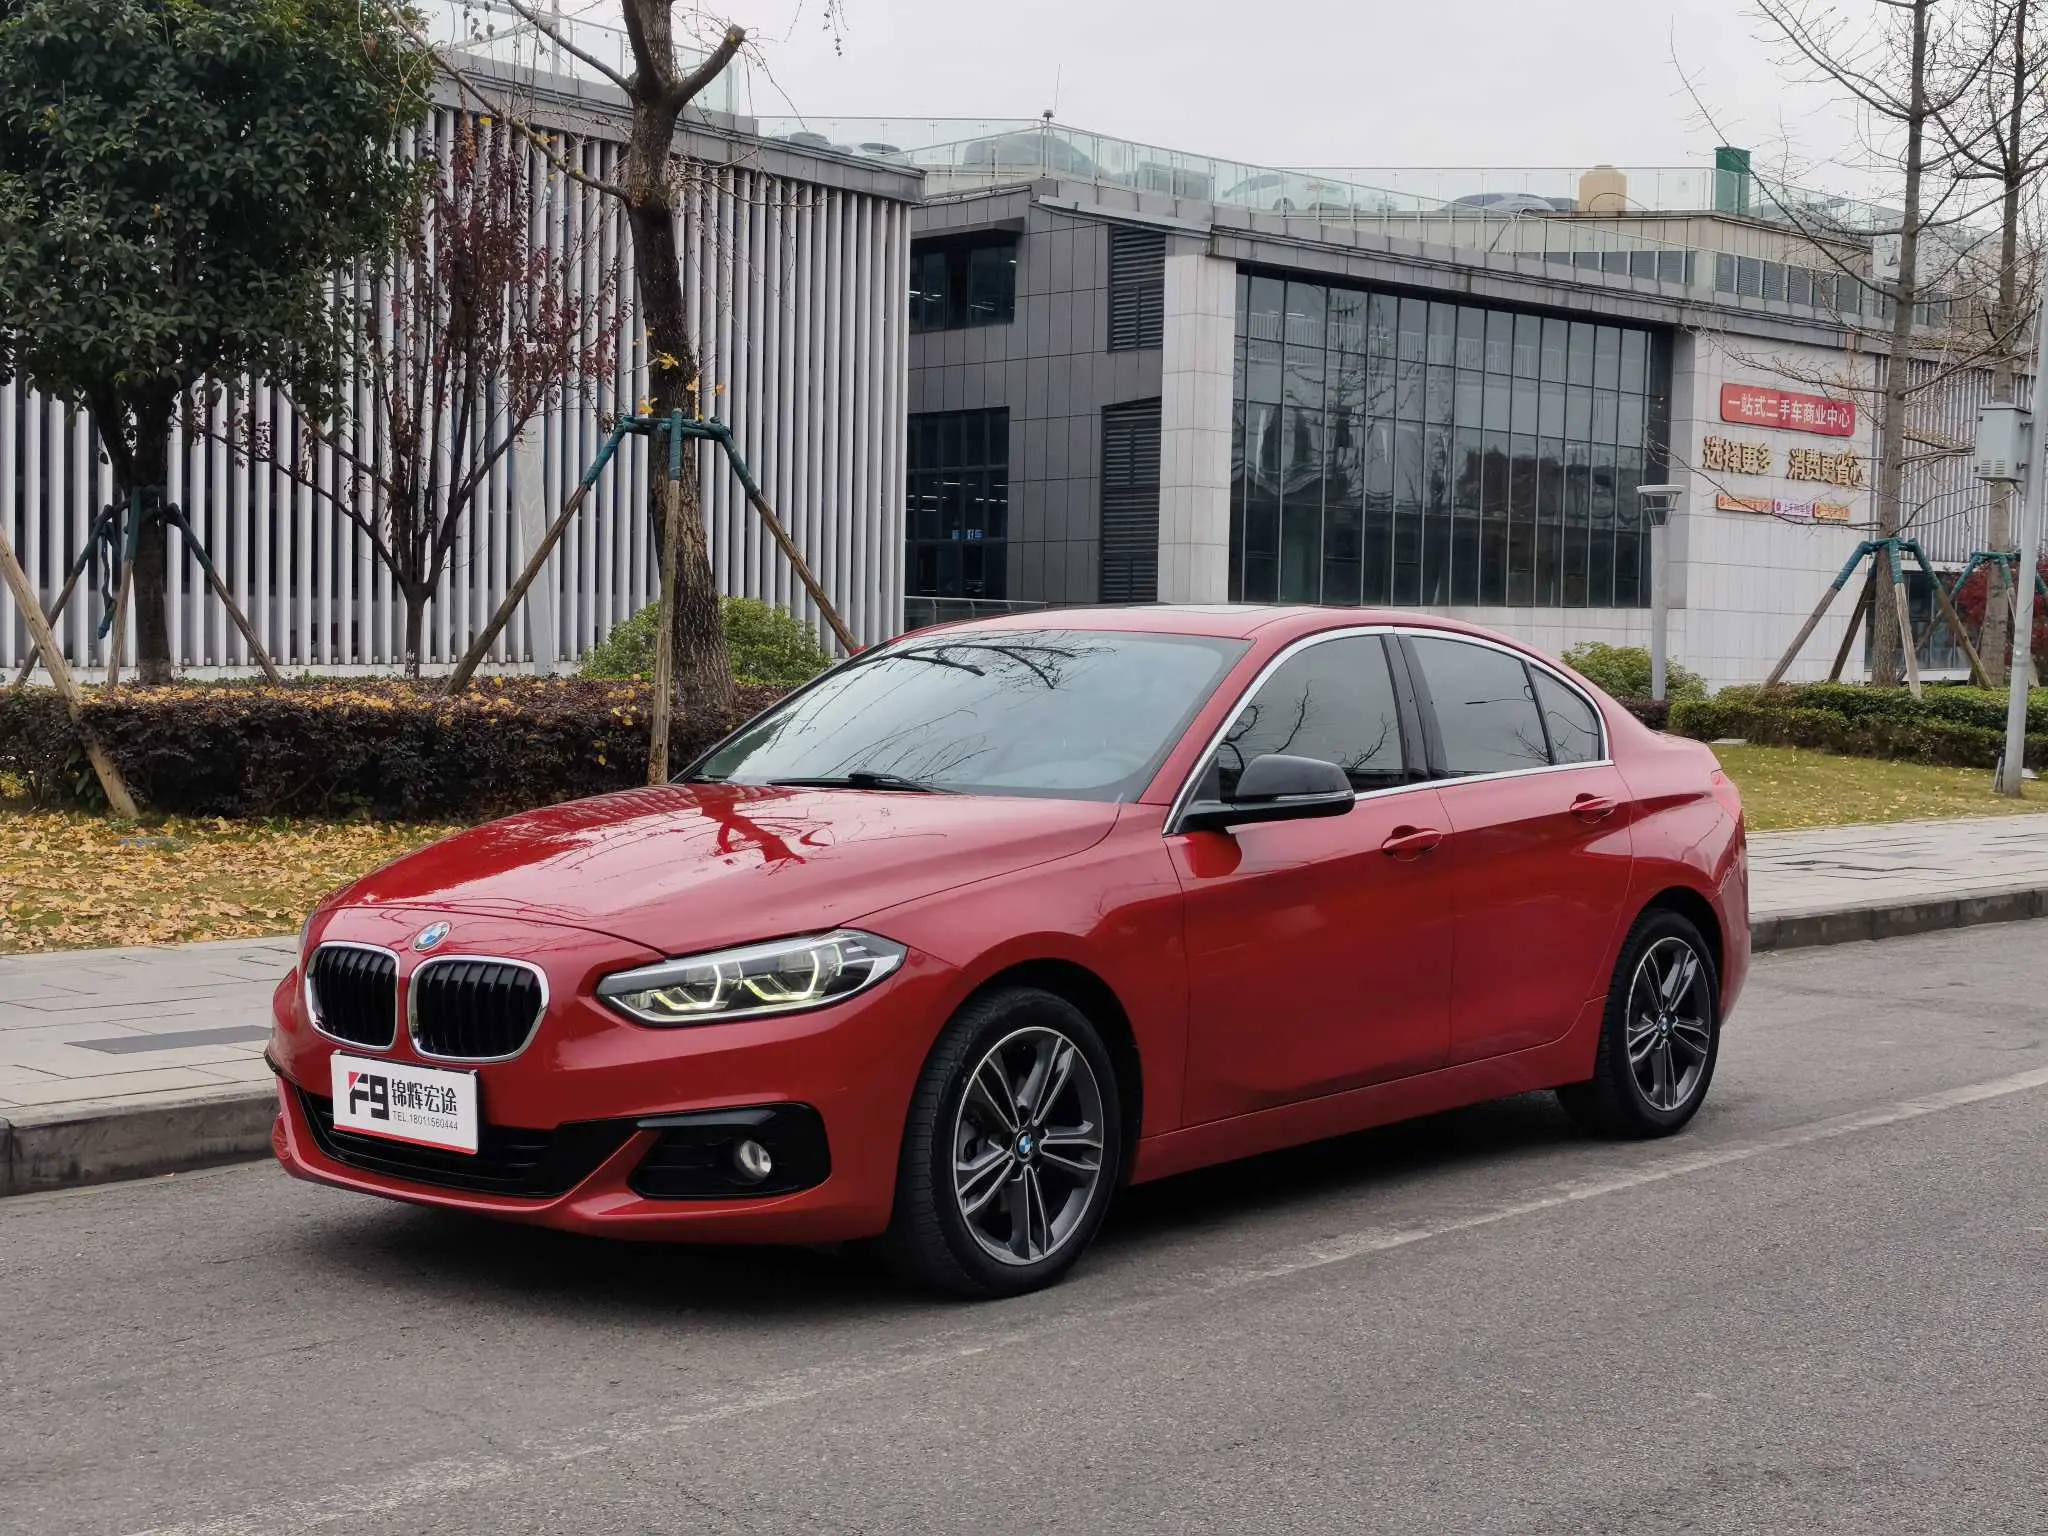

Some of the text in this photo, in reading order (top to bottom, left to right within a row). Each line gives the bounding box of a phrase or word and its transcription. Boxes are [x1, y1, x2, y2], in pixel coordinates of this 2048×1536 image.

[1728, 393, 1851, 428] 一站式二手车商业中心
[1703, 435, 1772, 475] 选择更多
[391, 1078, 457, 1116] 锦辉宏途
